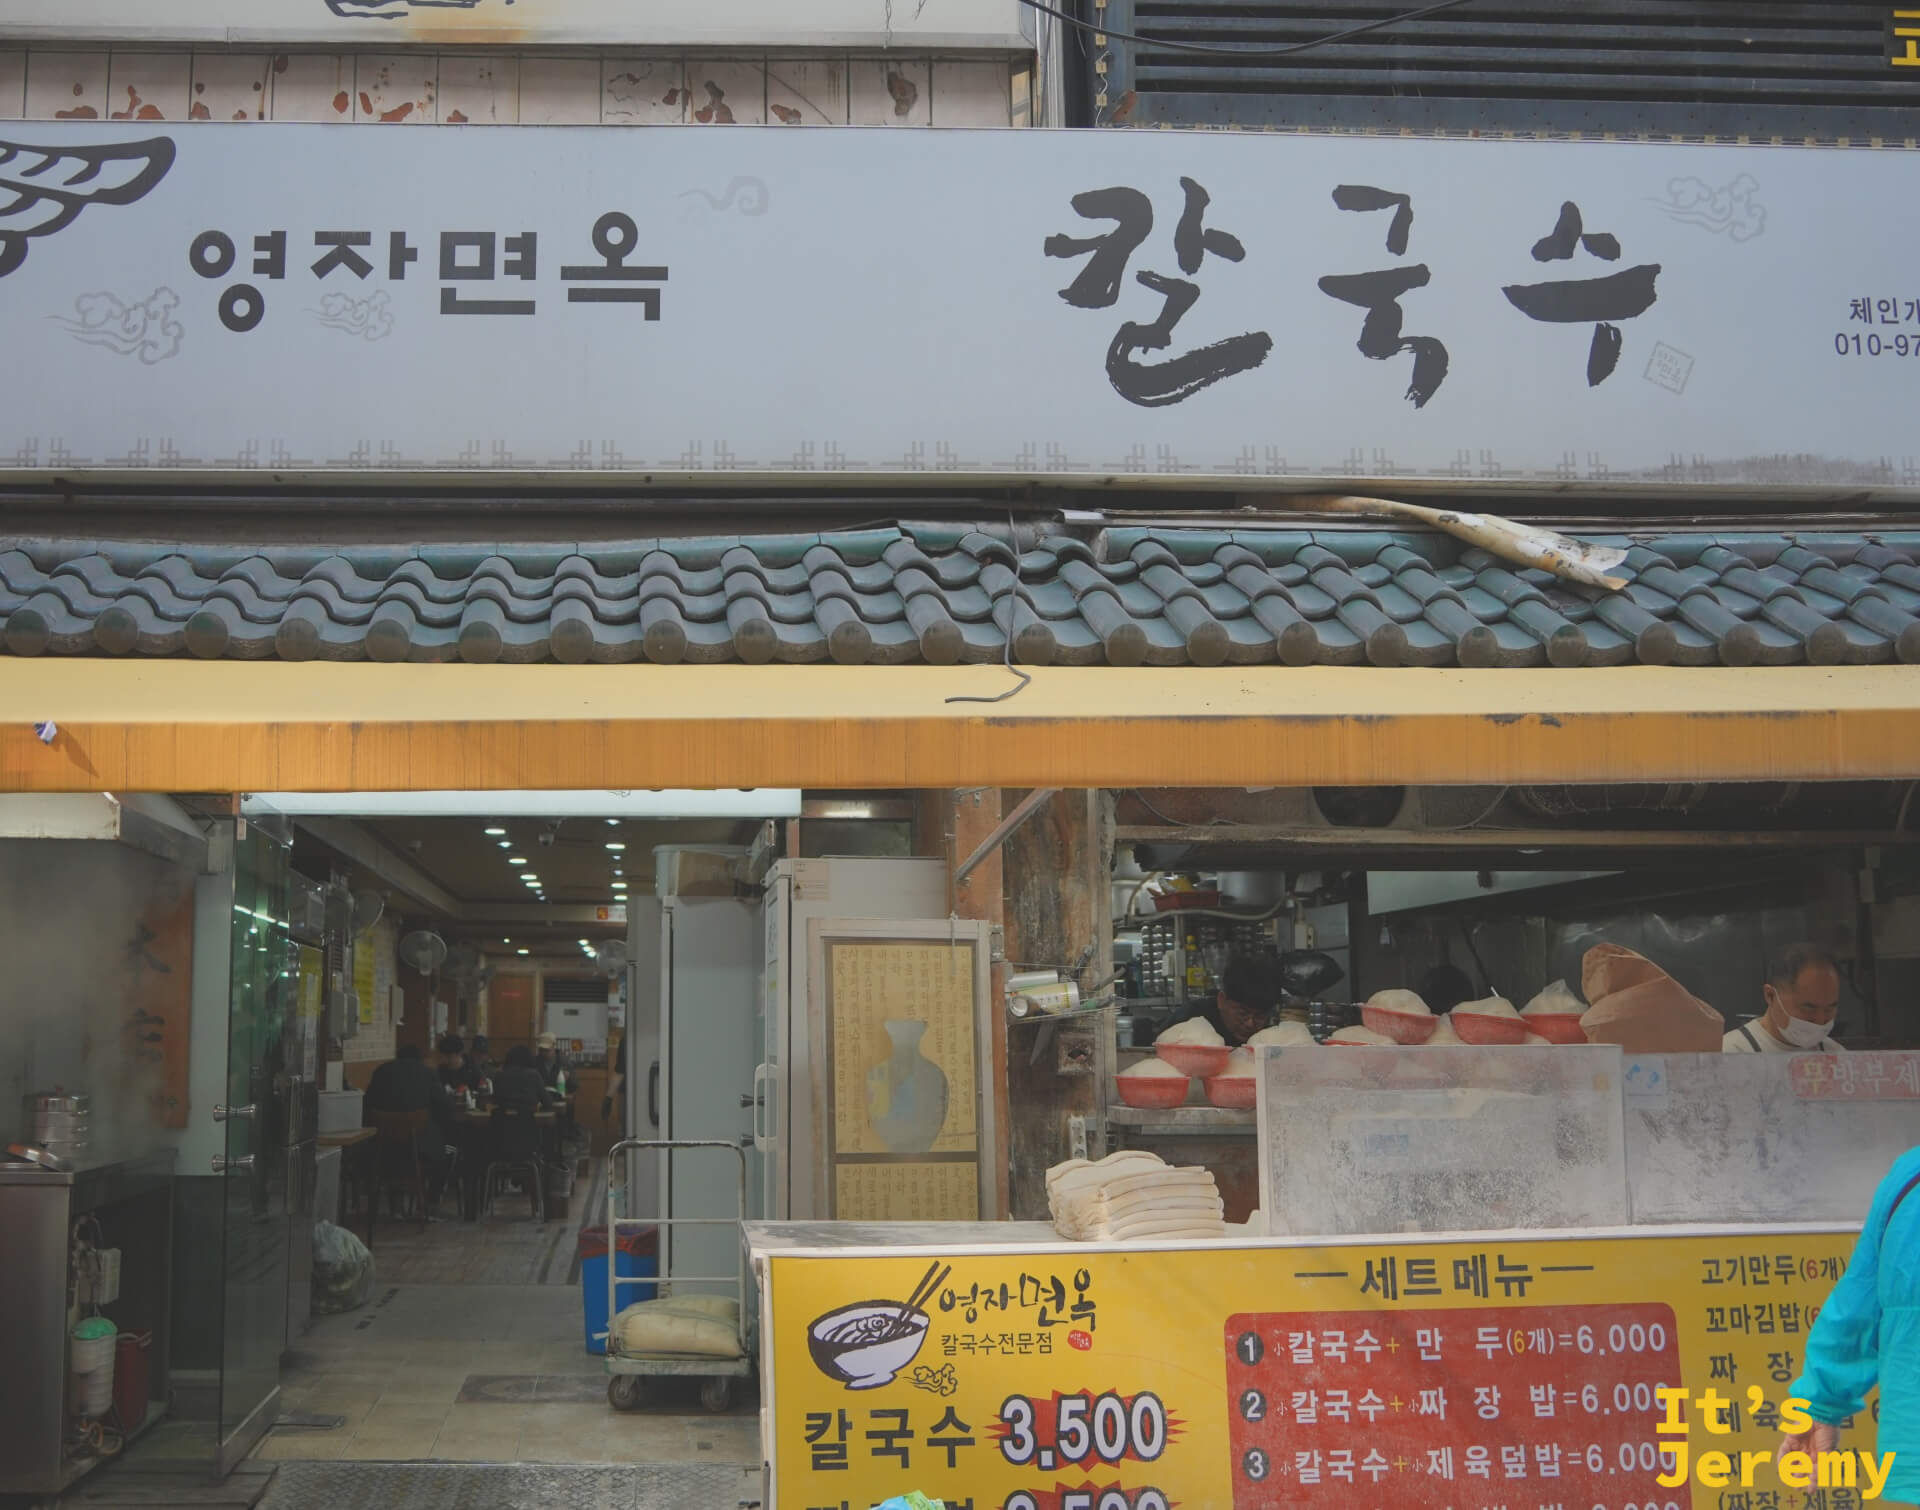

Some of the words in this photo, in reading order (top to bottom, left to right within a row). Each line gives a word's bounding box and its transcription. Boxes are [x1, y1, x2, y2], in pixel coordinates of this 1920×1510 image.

[189, 211, 669, 332] 영자면옥
[1044, 176, 1664, 408] 칼국수
[939, 1268, 1096, 1332] 영자면옥
[941, 1331, 1052, 1356] 칼국수전문점
[804, 1406, 976, 1471] 칼국수
[1000, 1392, 1167, 1471] 3.500
